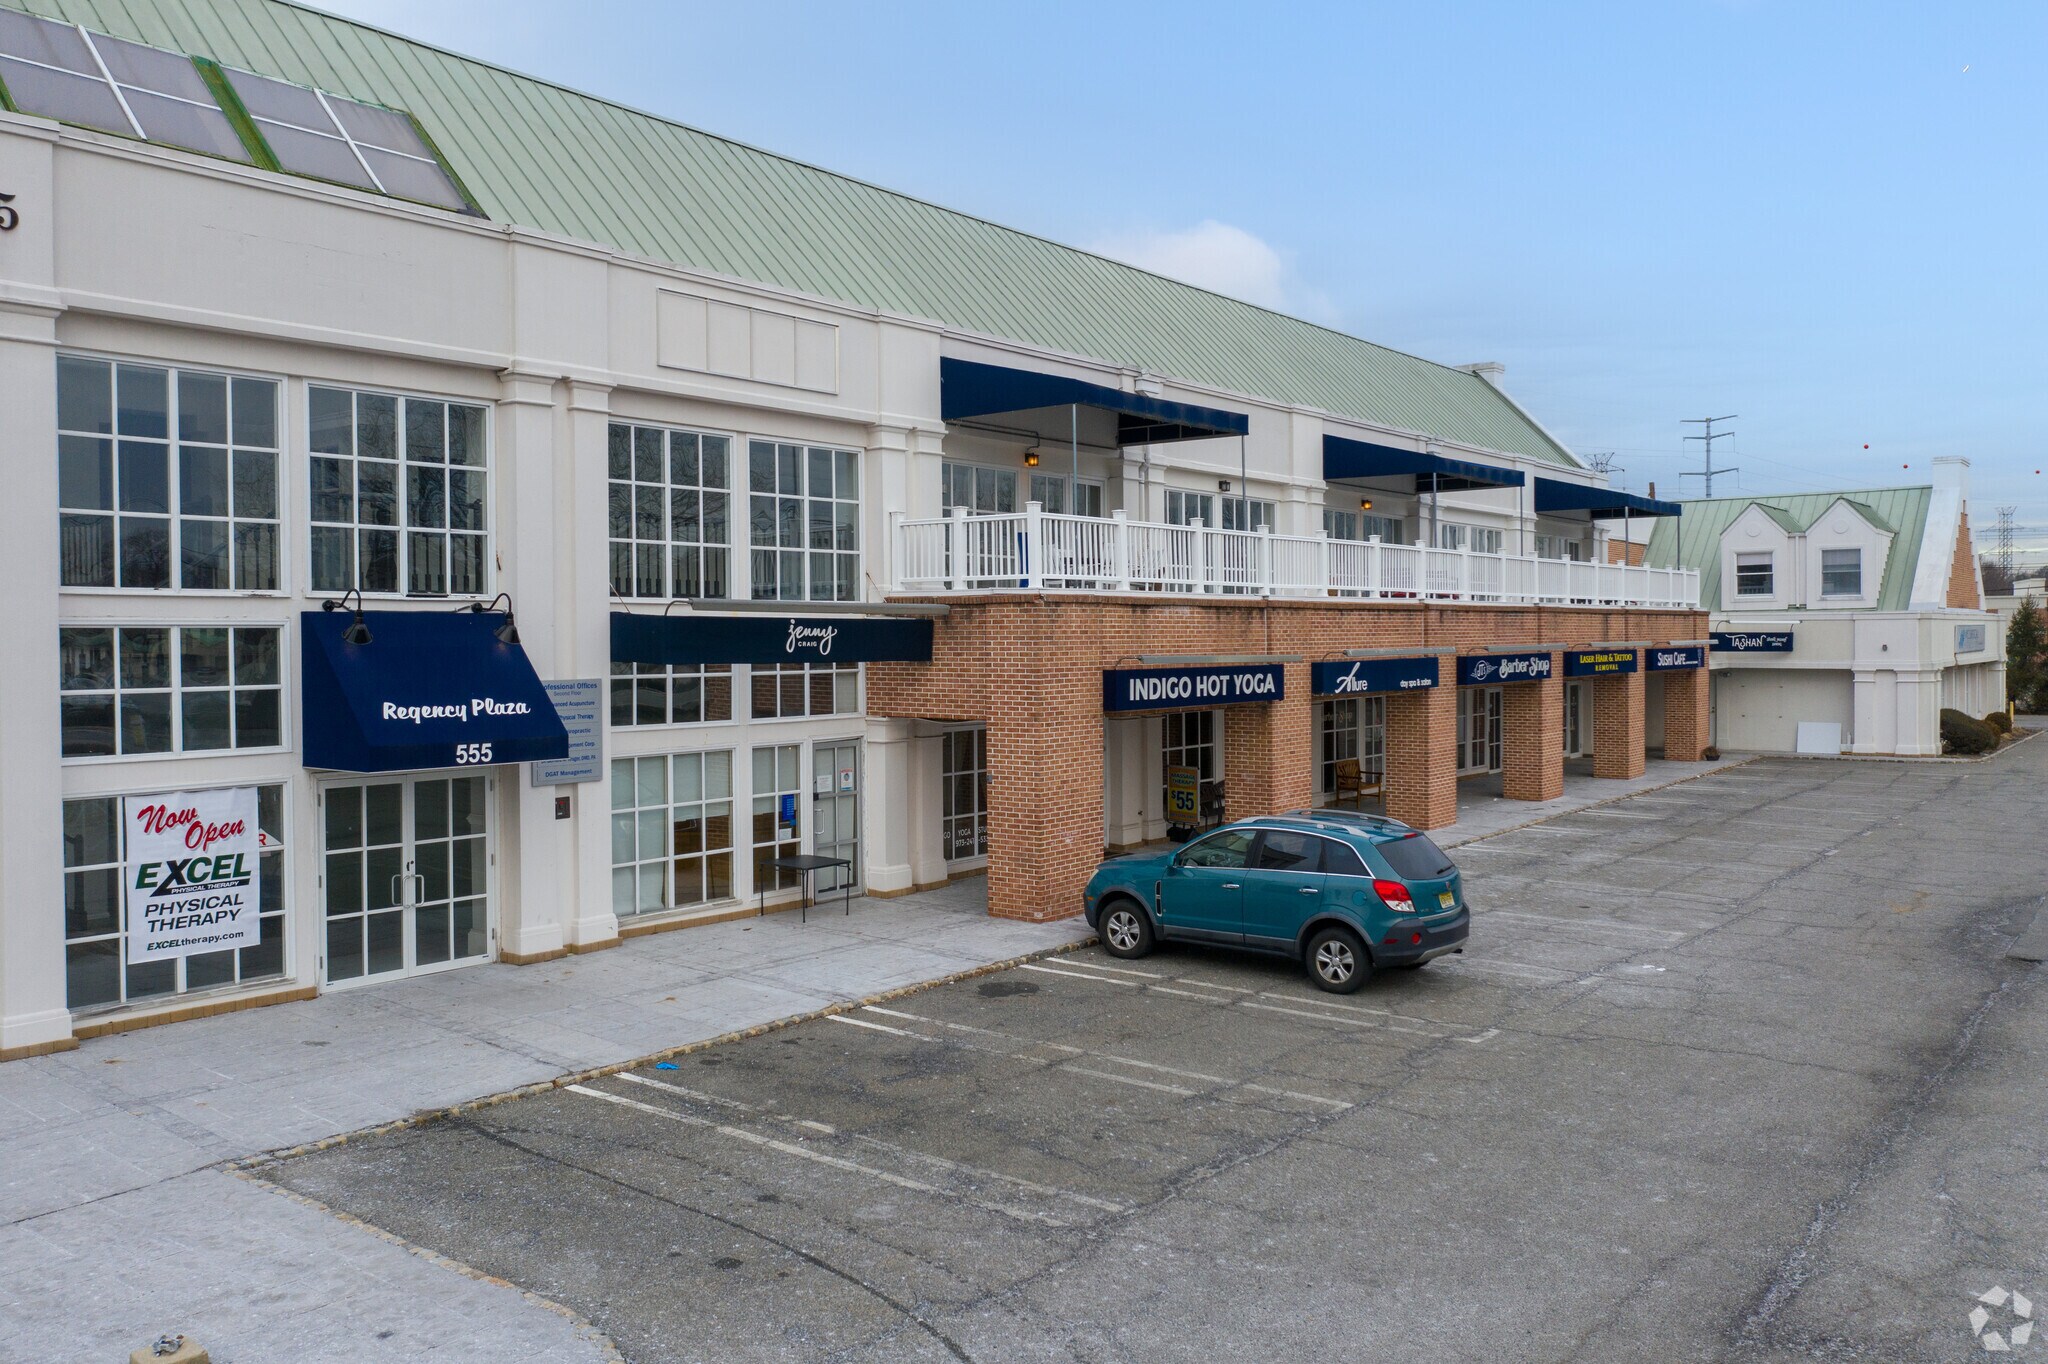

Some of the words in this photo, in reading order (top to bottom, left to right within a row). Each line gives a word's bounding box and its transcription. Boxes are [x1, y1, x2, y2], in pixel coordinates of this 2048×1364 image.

[786, 619, 838, 655] jenny
[1725, 634, 1766, 650] TASHAN
[1499, 659, 1529, 678] Barber
[1529, 657, 1550, 676] Shop
[1580, 655, 1595, 663] LASER
[1595, 654, 1608, 662] HAIR
[1608, 653, 1613, 662] &
[1613, 653, 1633, 661] TATTOO
[1657, 652, 1673, 666] SUSHI
[1674, 652, 1686, 665] CAFE
[1130, 676, 1192, 701] INDIGO
[1196, 675, 1230, 698] HOT
[1233, 673, 1276, 695] YOGA
[1335, 662, 1368, 694] Allure
[1421, 678, 1432, 686] salon
[383, 702, 467, 724] Regency
[472, 698, 531, 716] Plaza
[569, 700, 595, 708] Acupuncture
[577, 713, 594, 721] Therapy
[456, 743, 492, 764] 555
[1171, 790, 1195, 811] $55
[137, 804, 198, 834] Now
[185, 819, 245, 851] Open
[957, 828, 972, 837] YOGA
[135, 853, 252, 897] EXCEL
[171, 885, 206, 895] PHYSICAL
[207, 880, 240, 890] THERAPY
[145, 893, 244, 918] PHYSICAL
[148, 908, 241, 933] THERAPY
[147, 930, 244, 951] EXCELtherapy.com
